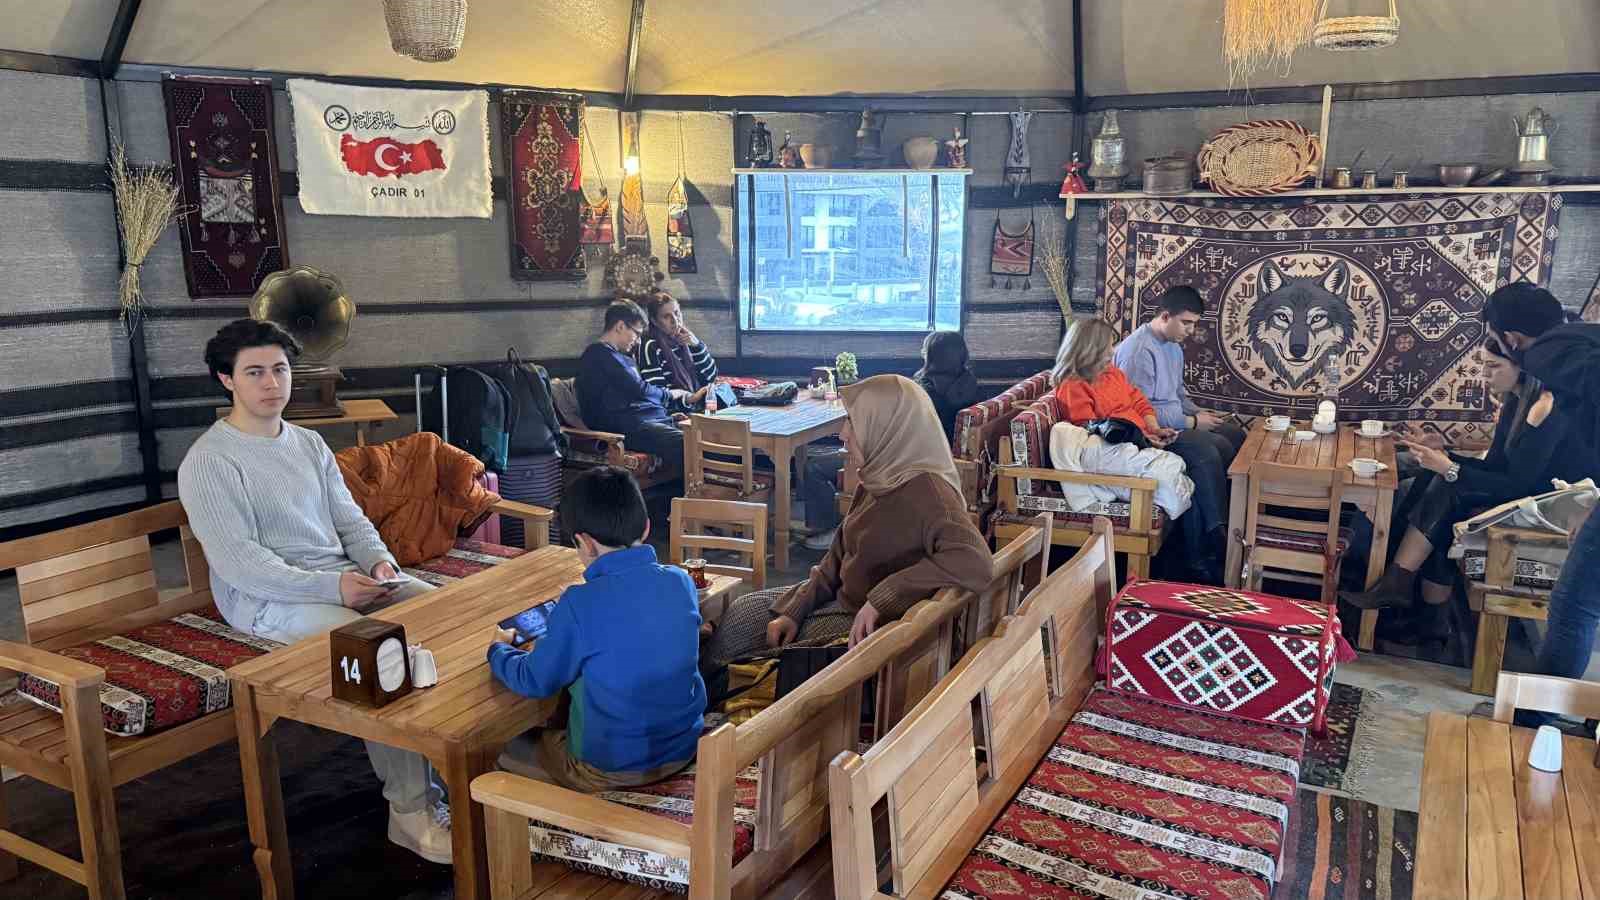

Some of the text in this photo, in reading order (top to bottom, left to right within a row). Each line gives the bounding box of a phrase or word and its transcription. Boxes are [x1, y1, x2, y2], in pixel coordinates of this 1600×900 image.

[370, 186, 425, 198] ÇADIR 01
[340, 655, 361, 685] 14
